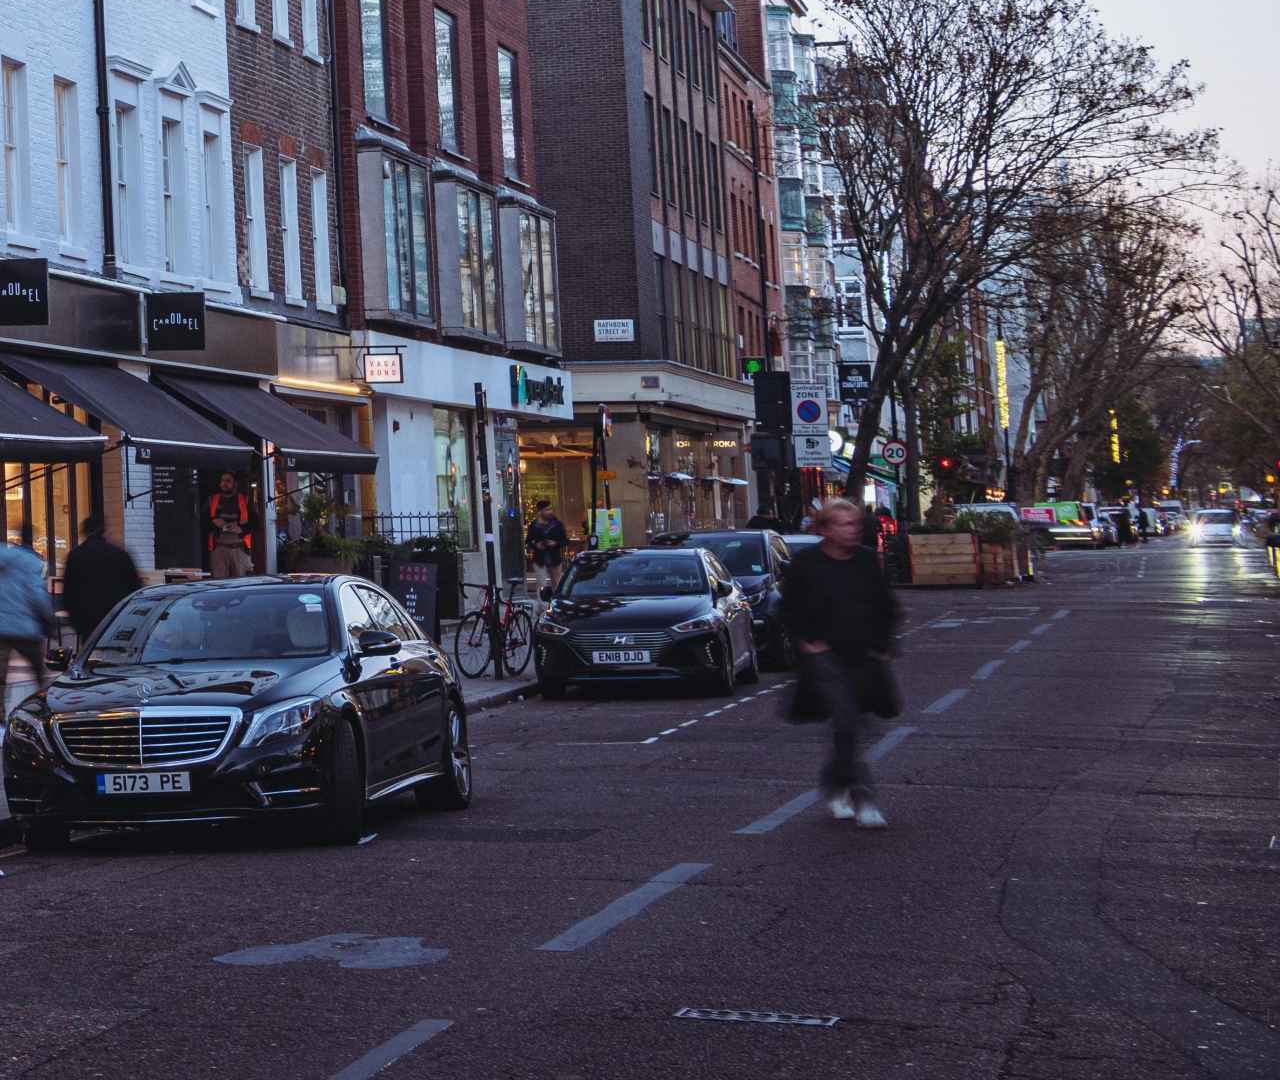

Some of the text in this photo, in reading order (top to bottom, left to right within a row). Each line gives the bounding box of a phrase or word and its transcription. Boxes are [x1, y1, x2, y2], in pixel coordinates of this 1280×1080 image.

[153, 312, 200, 331] CAROUSEL
[796, 391, 820, 399] ZONE
[713, 440, 737, 448] ROKA
[886, 447, 905, 458] 20
[112, 773, 182, 791] 5173 PE
